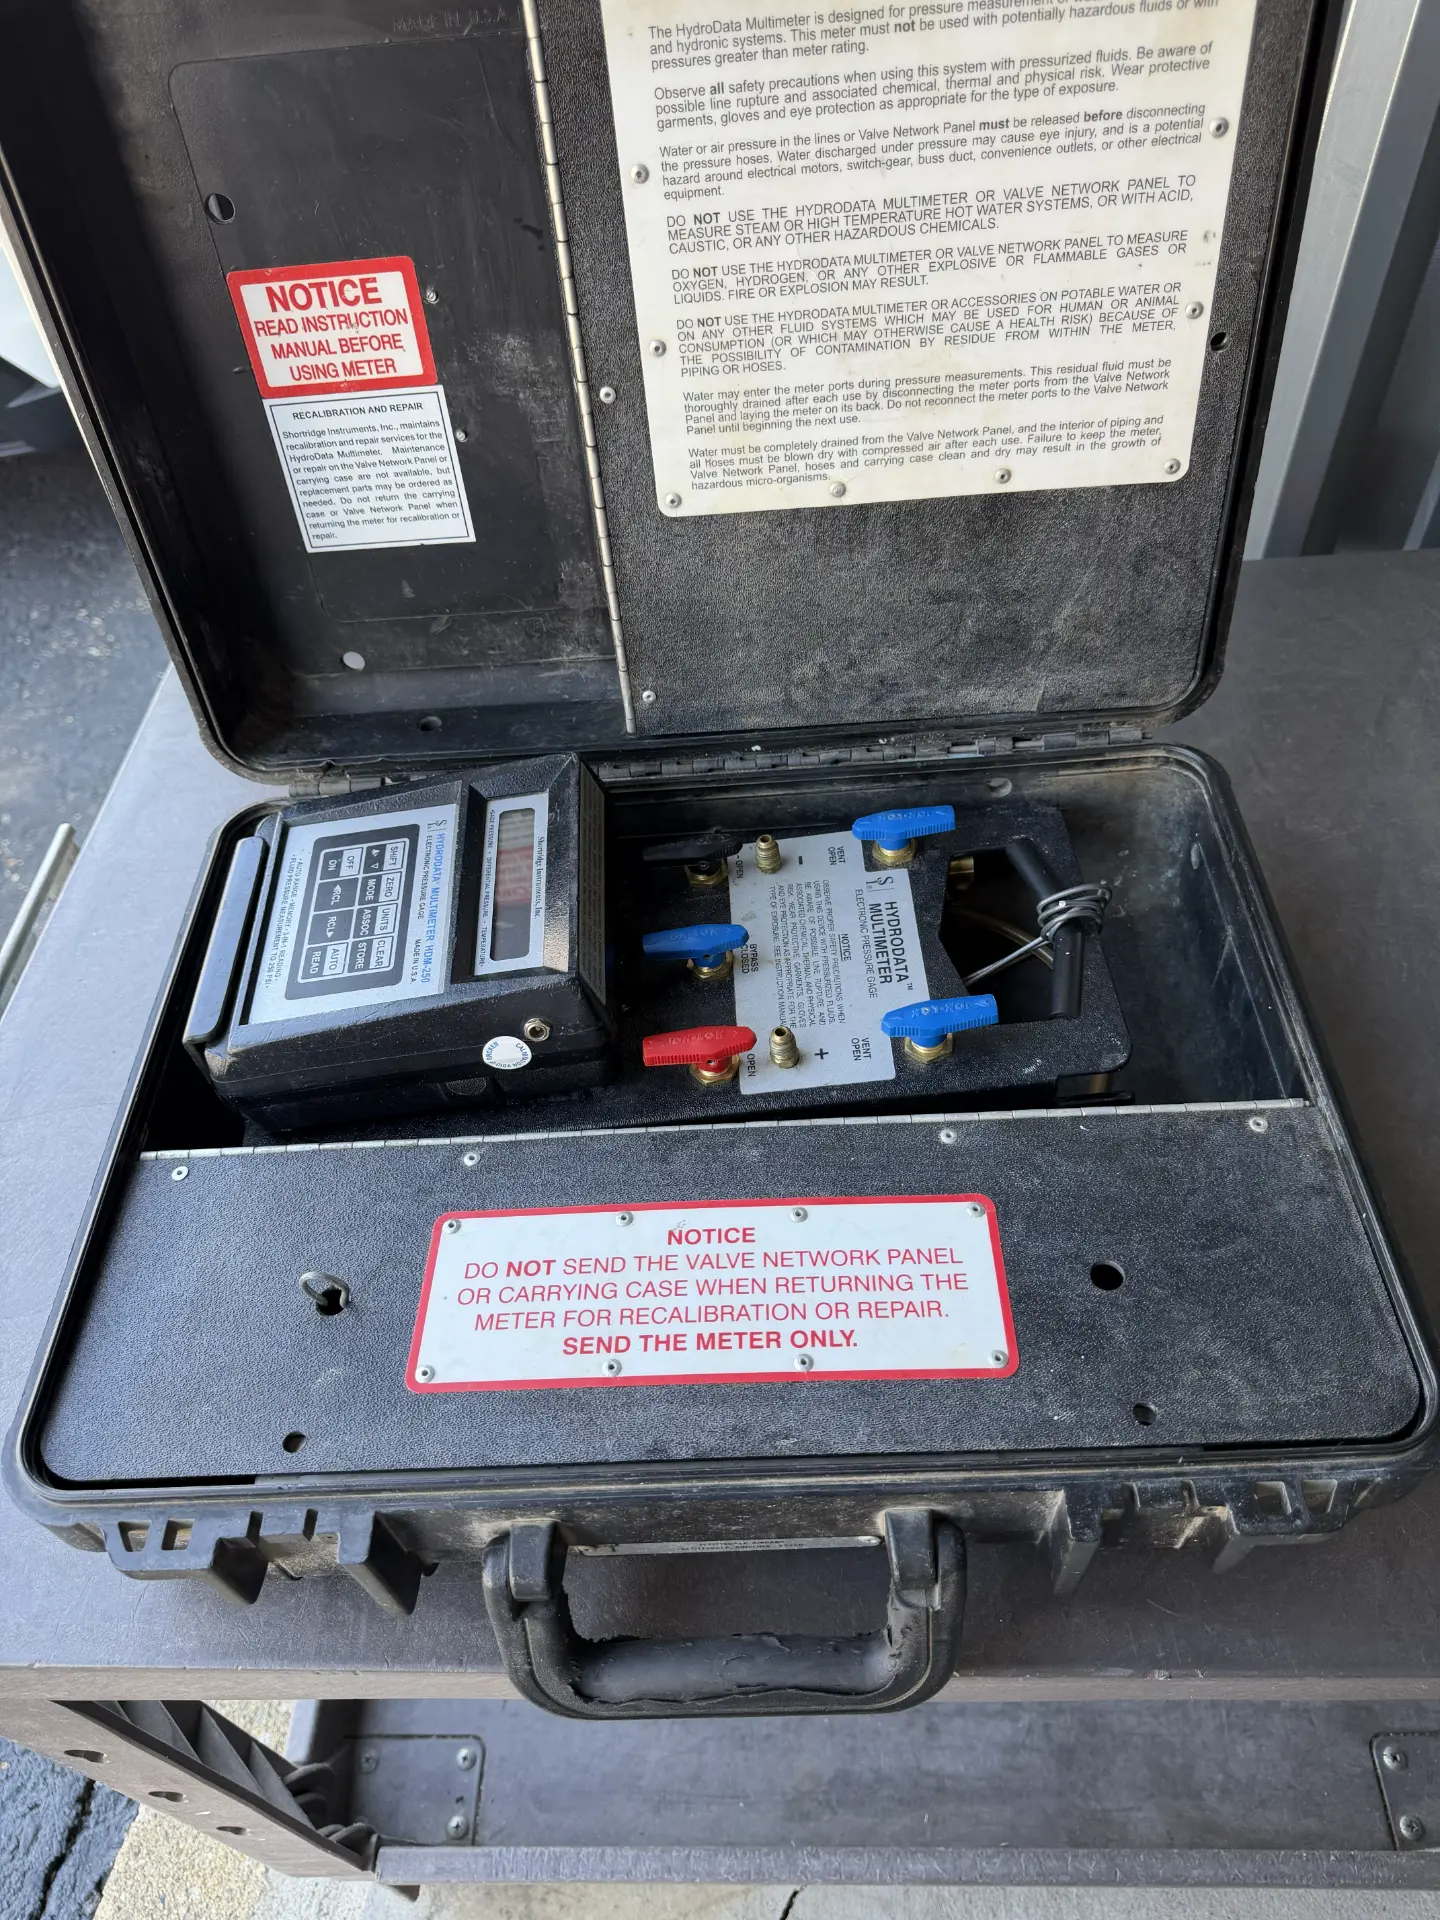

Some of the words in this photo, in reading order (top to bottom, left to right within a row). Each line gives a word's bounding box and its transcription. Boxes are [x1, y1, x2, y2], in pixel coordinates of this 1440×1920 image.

[651, 55, 711, 70] pressures
[714, 49, 758, 65] greater
[761, 47, 788, 59] than
[792, 43, 827, 57] meter
[831, 41, 868, 54] rating.
[654, 86, 705, 100] Observe
[709, 81, 724, 95] all
[728, 79, 764, 93] safety
[769, 73, 839, 91] precautions
[843, 70, 876, 83] when
[880, 66, 913, 80] using
[917, 64, 939, 77] this
[943, 61, 986, 77] system
[990, 57, 1015, 71] with
[1019, 50, 1091, 71] pressurized
[1096, 48, 1131, 62] fluids.
[1136, 46, 1153, 59] Be
[1157, 45, 1195, 58] aware
[1200, 41, 1213, 54] of
[656, 99, 705, 115] possible
[710, 97, 731, 109] line
[736, 94, 779, 108] rupture
[784, 89, 806, 103] and
[812, 83, 877, 101] associated
[882, 78, 939, 95] chemical,
[945, 74, 991, 89] thermal
[996, 72, 1019, 85] and
[1024, 67, 1074, 86] physical
[1080, 65, 1104, 78] risk.
[1111, 63, 1144, 76] Wear
[1148, 58, 1209, 76] protective
[666, 215, 685, 227] DO
[693, 212, 720, 225] NOT
[728, 209, 754, 222] USE
[761, 206, 787, 219] THE
[796, 199, 876, 216] HYDRODATA
[883, 192, 967, 209] MULTIMETER
[975, 189, 994, 202] OR
[1003, 185, 1043, 200] VALVE
[1051, 180, 1119, 196] NETWORK
[1127, 176, 1169, 190] PANEL
[1178, 174, 1195, 186] TO
[265, 276, 382, 312] NOTICE
[674, 290, 724, 304] LIQUIDS.
[728, 288, 755, 299] FIRE
[758, 286, 776, 297] OR
[780, 280, 848, 296] EXPLOSION
[852, 278, 877, 290] MAY
[881, 274, 928, 287] RESULT.
[253, 318, 298, 336] READ
[301, 308, 408, 332] INSTRUCTION
[270, 339, 337, 359] MANUAL
[337, 333, 403, 353] BEFORE
[289, 362, 339, 381] USING
[341, 357, 397, 377] METER
[292, 406, 365, 419] RECALIBRATION
[368, 405, 387, 413] AND
[389, 402, 423, 411] REPAIR
[282, 429, 326, 439] Shortridge
[327, 425, 379, 435] Instruments,
[399, 420, 440, 429] maintains
[686, 424, 715, 435] Panel
[718, 422, 739, 432] until
[742, 419, 792, 431] beginning
[795, 417, 811, 427] the
[814, 415, 836, 425] next
[839, 415, 860, 424] use.
[285, 440, 337, 450] recalibration
[338, 438, 354, 446] and
[355, 436, 378, 445] repair
[380, 434, 415, 442] services
[416, 432, 427, 440] for
[428, 431, 442, 439] the
[289, 452, 333, 463] HydroData
[336, 449, 382, 458] Multimeter.
[391, 444, 445, 453] Maintenance
[303, 464, 326, 473] repair
[354, 460, 377, 468] Valve
[378, 457, 413, 466] Network
[413, 455, 437, 464] Panel
[345, 855, 354, 869] OFF
[388, 846, 398, 865] SHIFT
[423, 835, 432, 869] ELECTRONIC
[535, 836, 544, 866] Shortridge
[827, 846, 836, 865] OPEN
[836, 846, 845, 863] VENT
[327, 859, 337, 870] ON
[735, 860, 743, 878] OPEN
[365, 878, 376, 901] MODE
[384, 876, 394, 897] ZERO
[419, 870, 428, 901] PRESSURE
[534, 868, 543, 906] Instruments,
[359, 909, 371, 935] ASSOC
[379, 907, 390, 930] UNITS
[417, 902, 425, 919] GAGE
[425, 887, 439, 941] MULTIMETER
[855, 888, 868, 933] ELECTRONIC
[354, 942, 366, 969] STORE
[374, 940, 385, 967] CLEAR
[413, 939, 421, 956] MADE
[841, 933, 851, 960] NOTICE
[861, 935, 874, 974] PRESSURE
[868, 903, 892, 983] MULTIMETER
[309, 951, 321, 973] READ
[328, 948, 339, 970] AUTO
[749, 943, 758, 972] BYPASS
[866, 976, 877, 998] GAGE
[851, 1037, 861, 1060] OPEN
[861, 1037, 871, 1058] VENT
[746, 1053, 755, 1076] OPEN
[667, 1227, 755, 1245] NOTICE
[464, 1262, 498, 1279] DO
[506, 1259, 556, 1277] NOT
[563, 1256, 625, 1275] SEND
[633, 1254, 678, 1271] THE
[685, 1252, 754, 1269] VALVE
[763, 1249, 880, 1267] NETWORK
[887, 1248, 963, 1264] PANEL
[457, 1287, 491, 1305] OR
[498, 1282, 617, 1303] CARRYING
[625, 1279, 687, 1298] CASE
[696, 1278, 766, 1295] WHEN
[775, 1274, 913, 1293] RETURNING
[920, 1273, 968, 1290] THE
[475, 1311, 555, 1330] METER
[563, 1309, 611, 1327] FOR
[619, 1303, 806, 1325] RECALIBRATION
[815, 1302, 849, 1319] OR
[858, 1300, 948, 1318] REPAIR.
[563, 1335, 630, 1355] SEND
[639, 1333, 686, 1352] THE
[696, 1331, 781, 1350] METER
[790, 1329, 857, 1348] ONLY.
